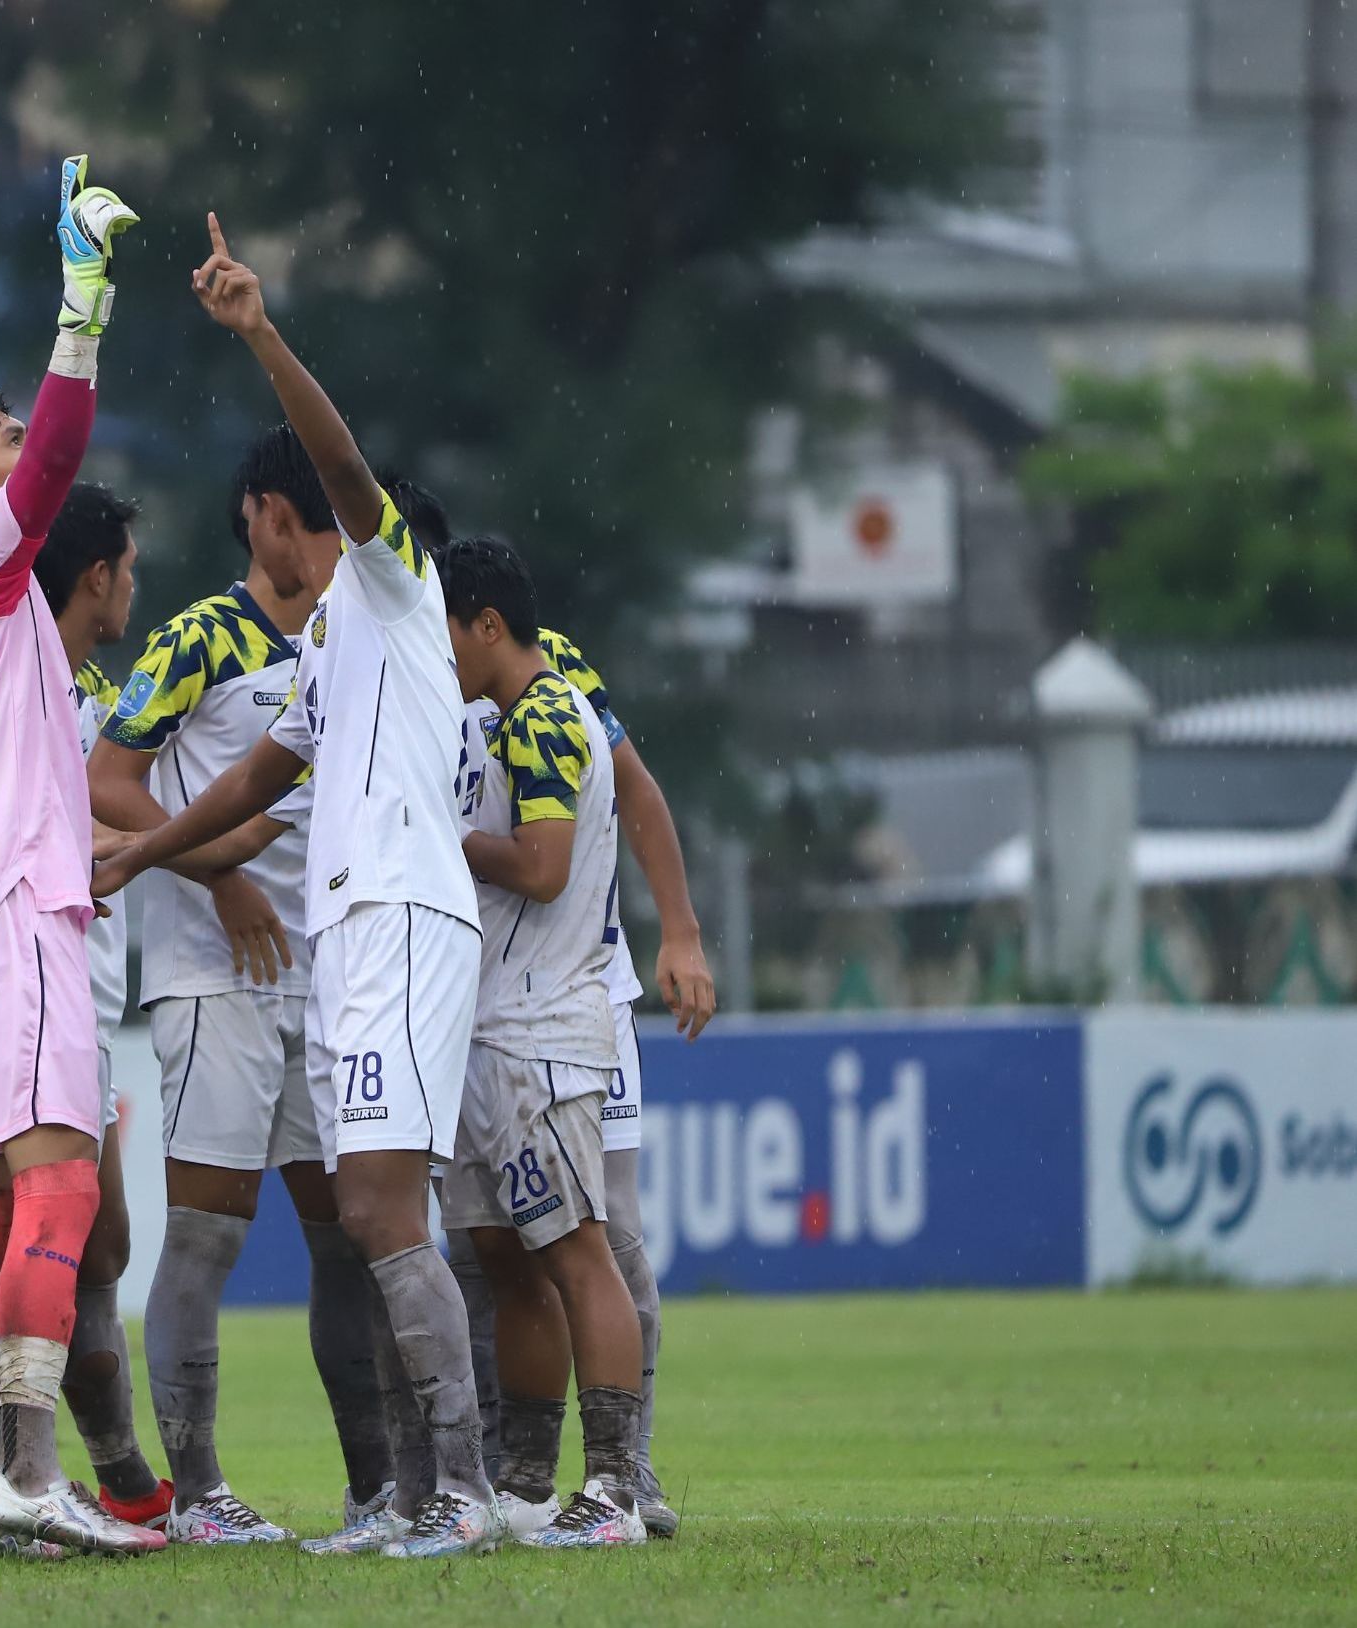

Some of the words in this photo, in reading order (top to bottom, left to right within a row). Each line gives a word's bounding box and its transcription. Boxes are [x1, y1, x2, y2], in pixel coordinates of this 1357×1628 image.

[263, 693, 287, 704] CURV
[342, 1051, 383, 1104] 78
[502, 1149, 549, 1210] 28
[45, 1250, 79, 1270] CUR
